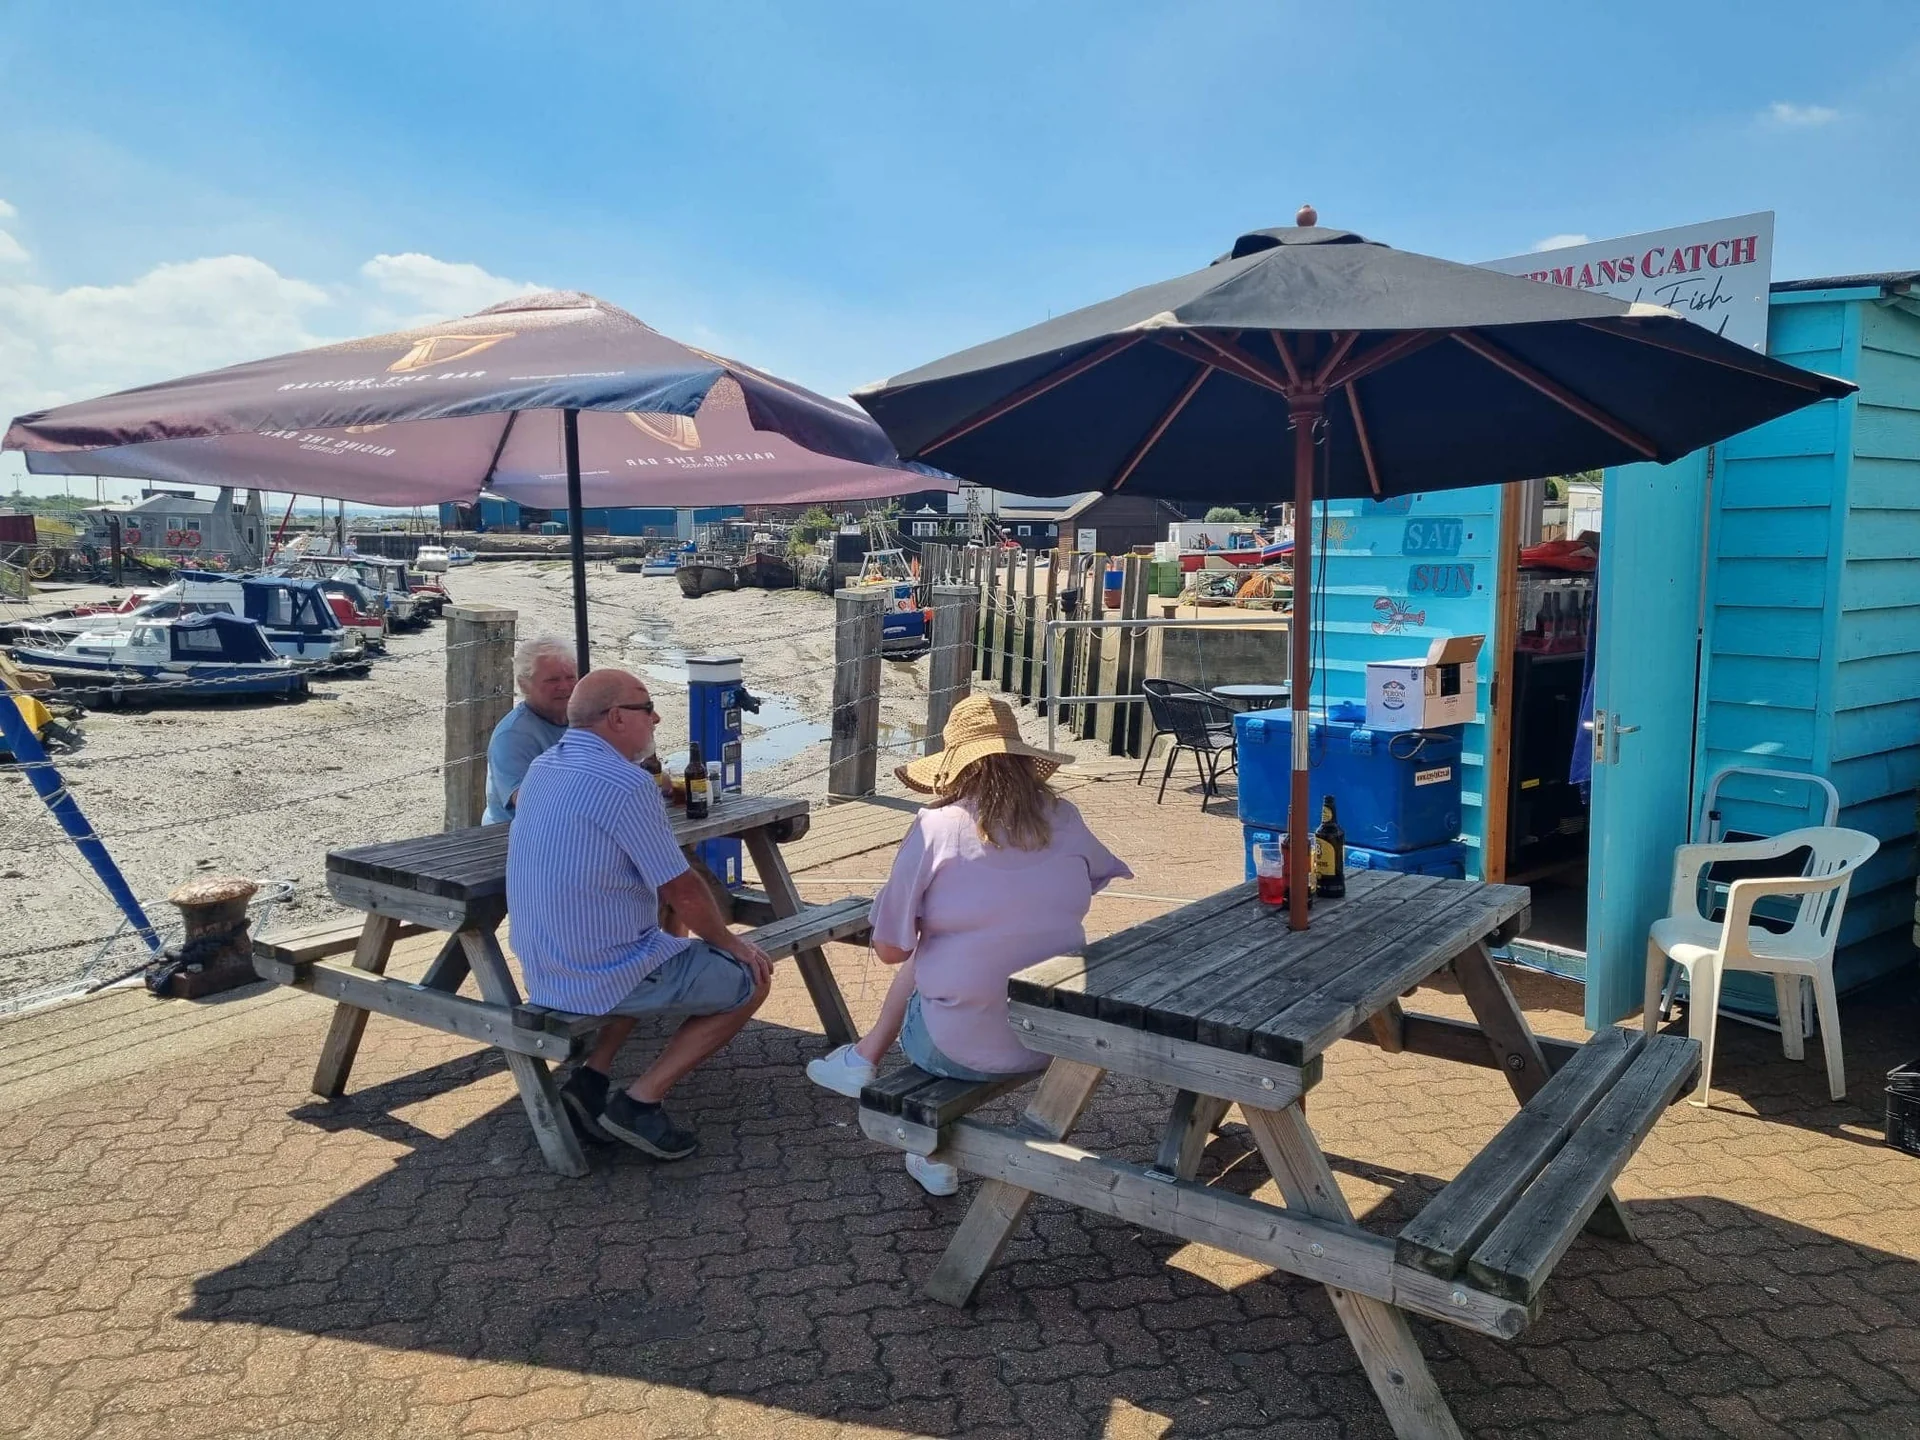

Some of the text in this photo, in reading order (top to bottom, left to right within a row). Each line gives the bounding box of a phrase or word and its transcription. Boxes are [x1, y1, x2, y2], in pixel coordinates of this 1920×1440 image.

[1640, 235, 1759, 279] CATCH
[1655, 275, 1732, 311] Fish
[1406, 523, 1462, 550] SAT
[1411, 564, 1475, 593] SUN
